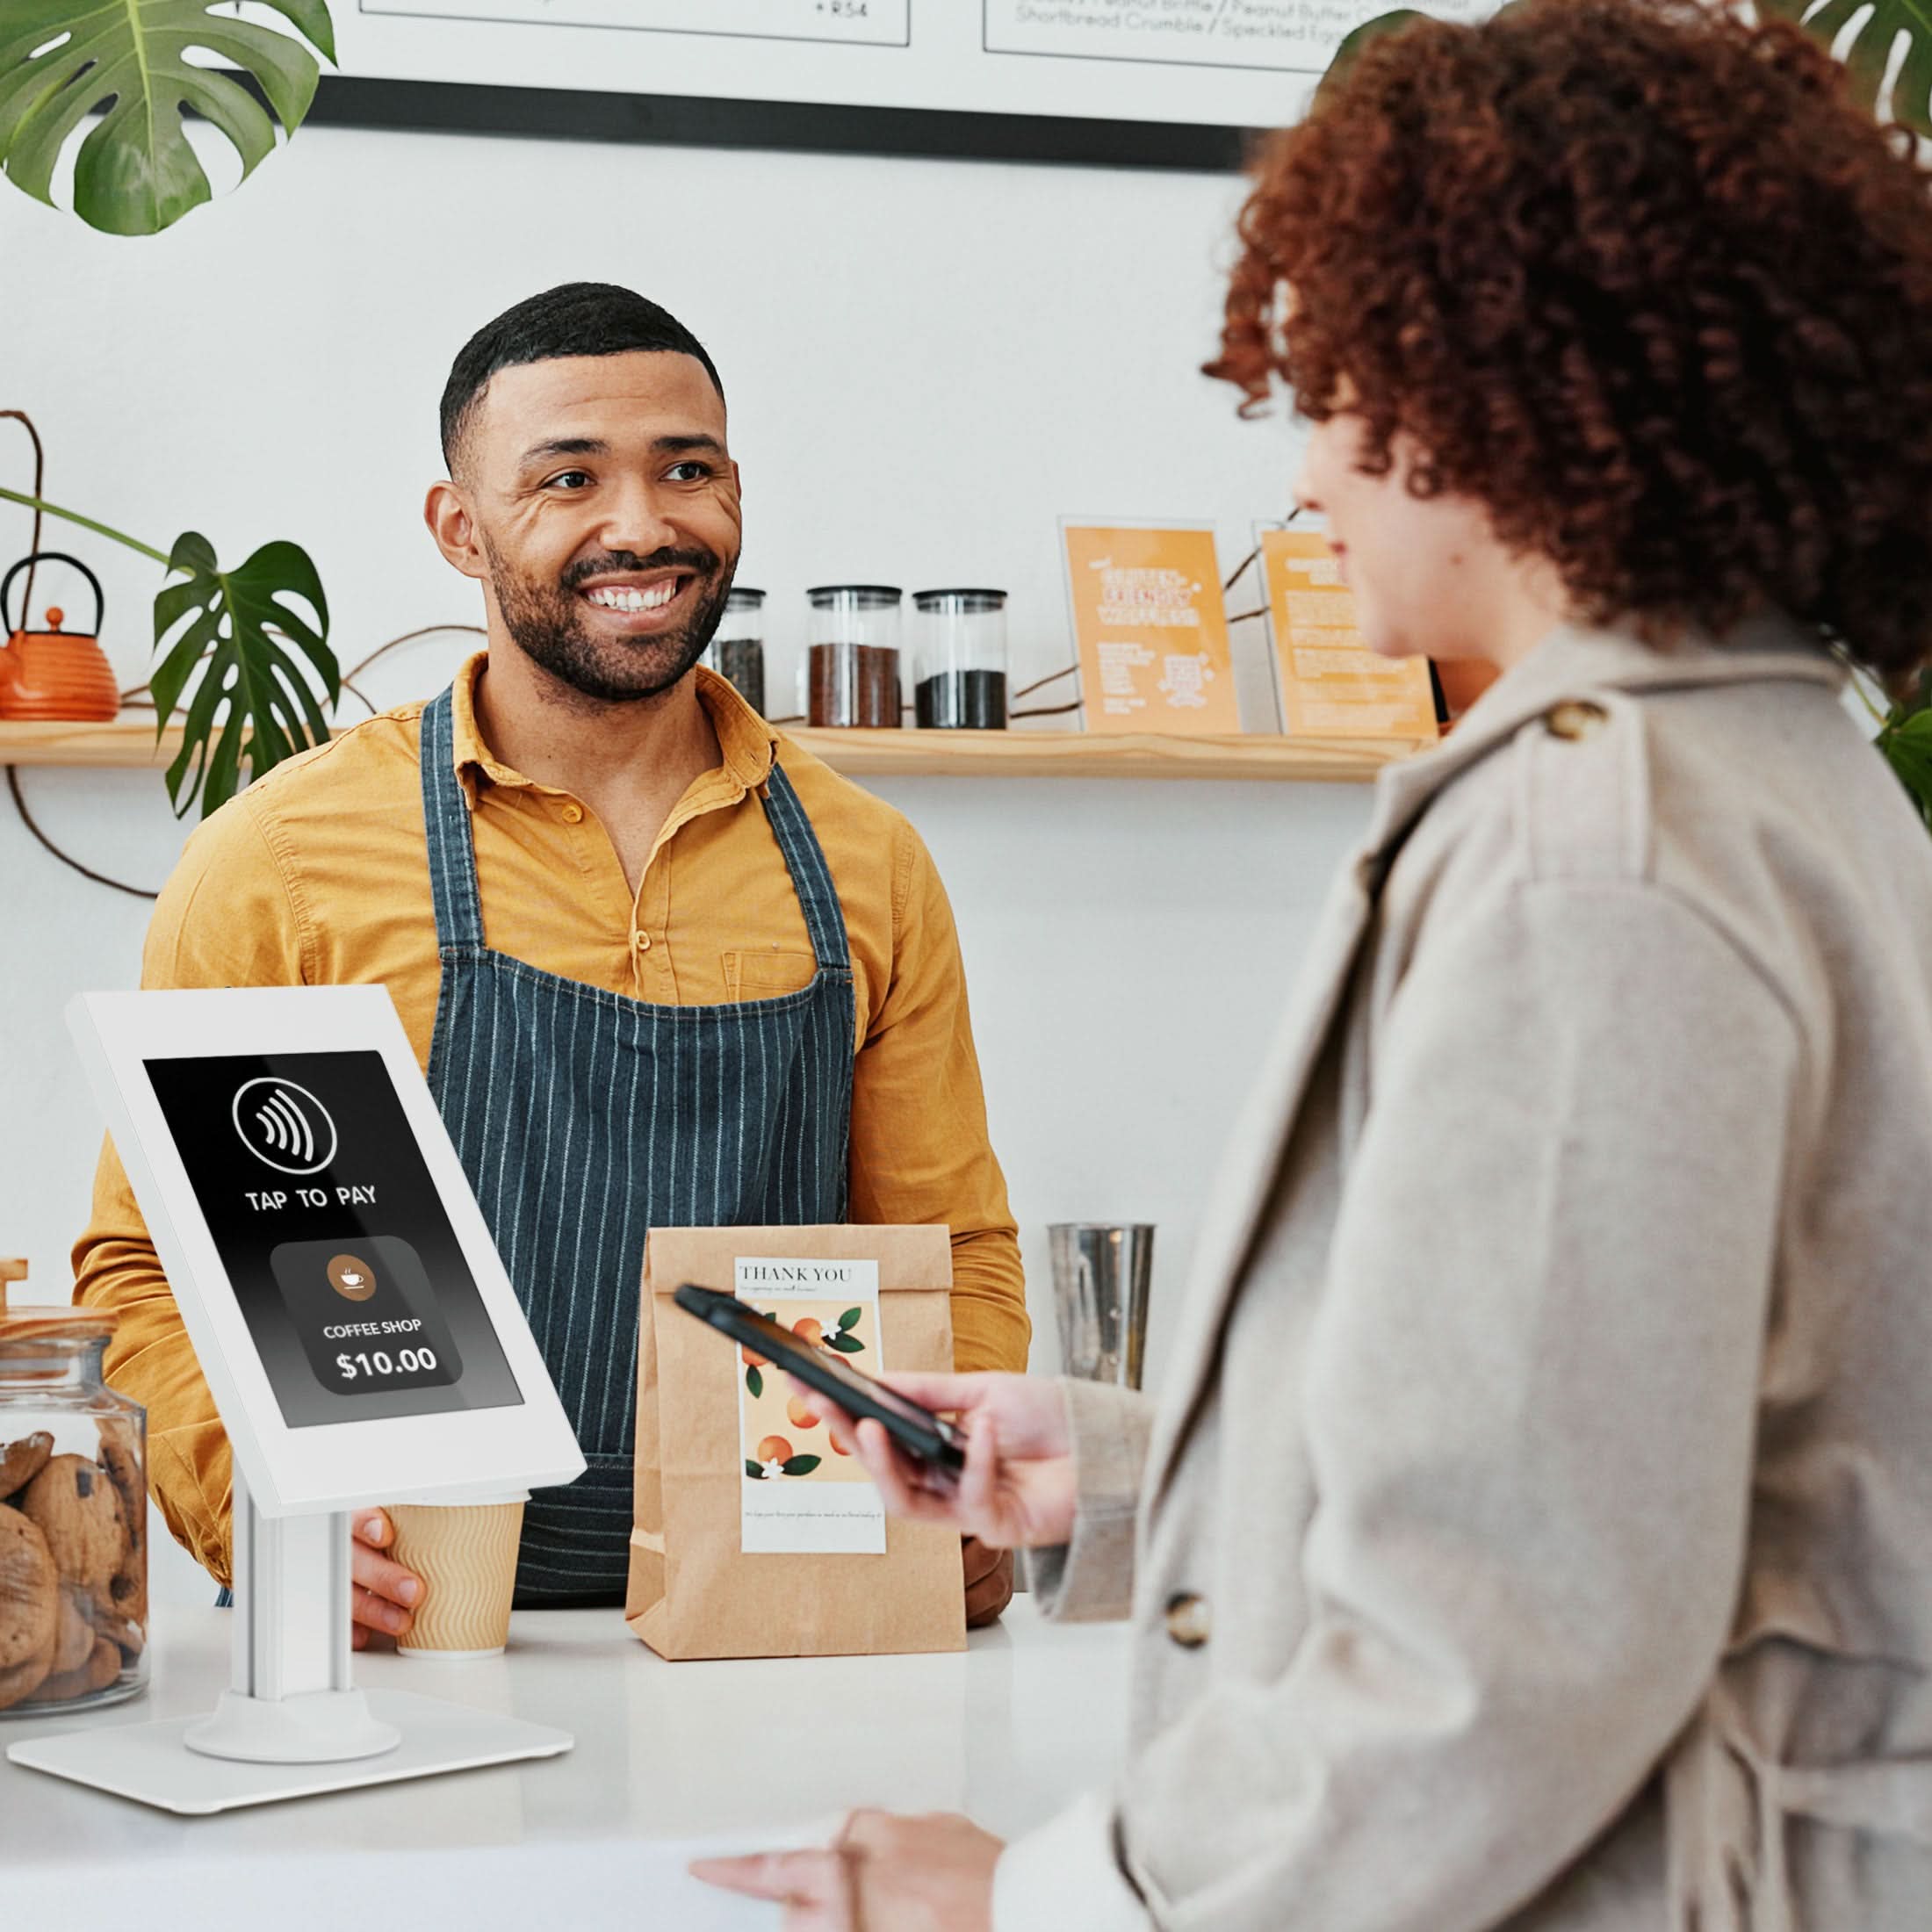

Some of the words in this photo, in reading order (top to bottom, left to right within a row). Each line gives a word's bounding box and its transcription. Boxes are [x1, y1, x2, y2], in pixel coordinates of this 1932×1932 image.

[1230, 0, 1294, 17] Peanut
[1298, 4, 1352, 21] Butter
[1016, 5, 1121, 28] Shortbread
[1125, 11, 1203, 32] Crumble
[1222, 18, 1305, 41] Speckled
[245, 1191, 287, 1211] TAP
[296, 1188, 328, 1208] TO
[336, 1185, 377, 1206] PAY
[739, 1265, 808, 1281] THANK
[813, 1267, 852, 1282] YOU
[323, 1322, 381, 1339] COFFEE
[381, 1318, 422, 1335] SHOP
[336, 1347, 437, 1380] $10.00
